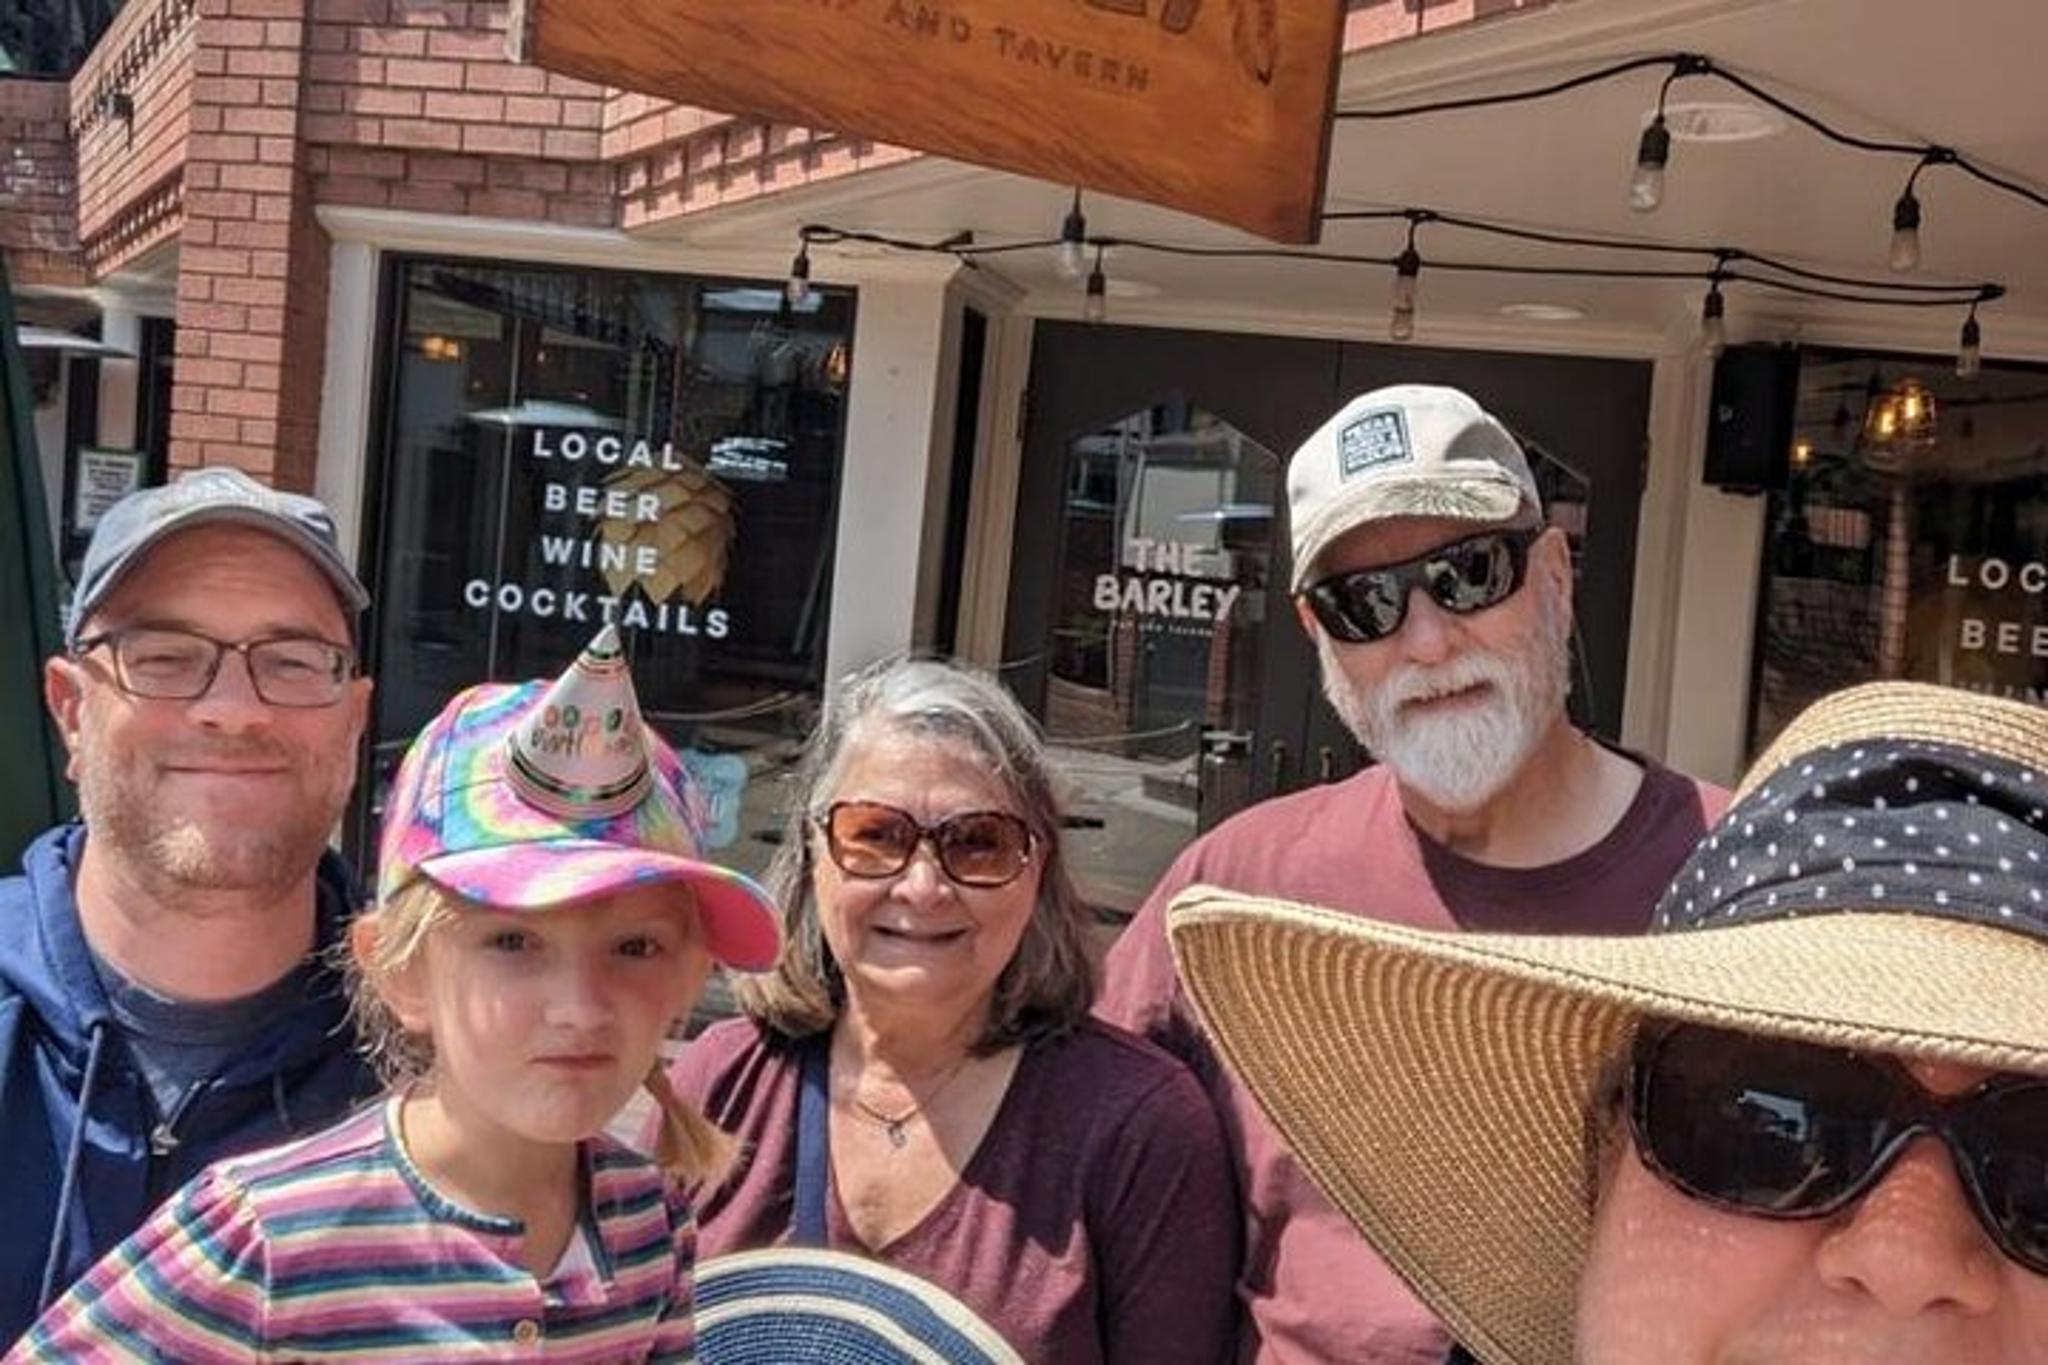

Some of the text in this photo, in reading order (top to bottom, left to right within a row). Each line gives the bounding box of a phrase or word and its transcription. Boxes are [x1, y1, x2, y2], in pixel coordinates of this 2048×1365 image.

[883, 2, 1150, 92] AND TAVERN
[532, 429, 683, 470] LOCAL
[545, 484, 660, 521] BEER
[541, 535, 658, 574] WINE
[1128, 537, 1206, 574] THE
[464, 579, 729, 638] COCKTAILS
[1093, 574, 1241, 621] BARLEY
